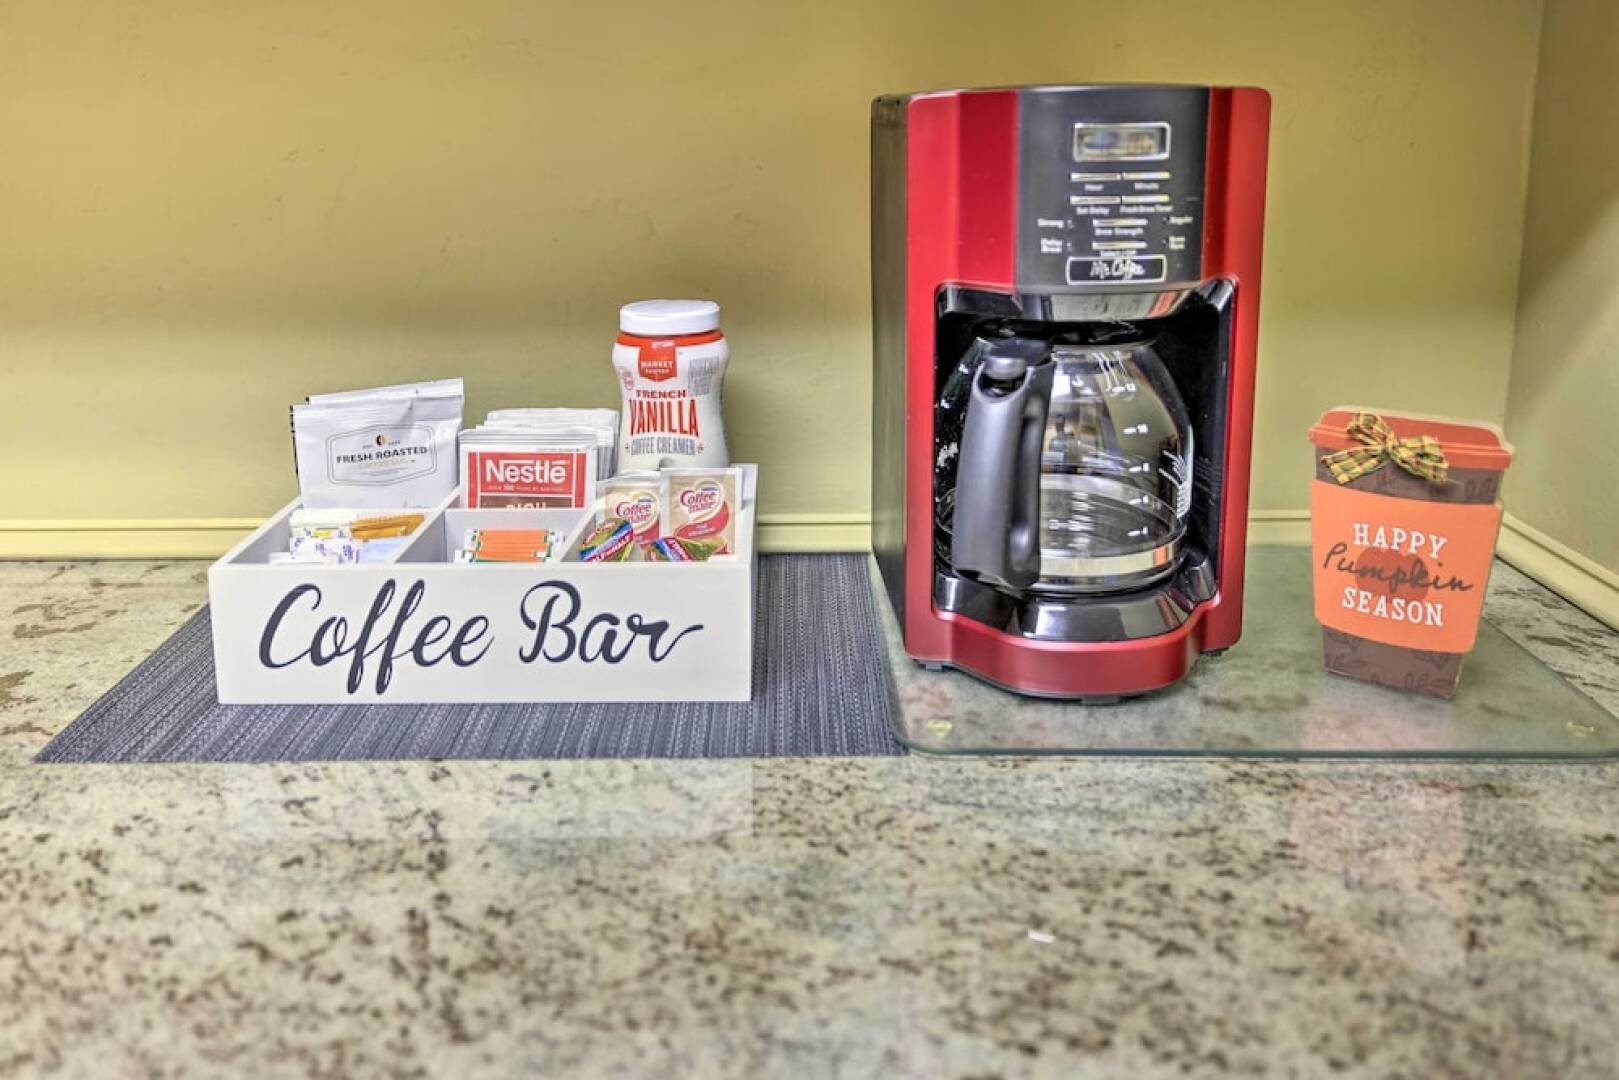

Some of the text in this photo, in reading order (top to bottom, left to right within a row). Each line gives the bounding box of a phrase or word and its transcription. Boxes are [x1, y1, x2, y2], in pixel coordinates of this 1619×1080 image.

[1112, 257, 1146, 281] Coffee
[635, 389, 687, 399] FRENCH
[629, 399, 699, 437] VANILLA
[336, 452, 374, 464] FRESH
[375, 446, 428, 460] ROASTED
[631, 436, 698, 456] COFFEE CREAMER
[616, 501, 652, 516] Coffee
[680, 489, 718, 507] Coffee
[1352, 522, 1448, 560] HAPPY
[1323, 541, 1474, 594] Pumpkin
[1341, 586, 1444, 627] SEASON
[259, 578, 705, 695] Coffee Bar
